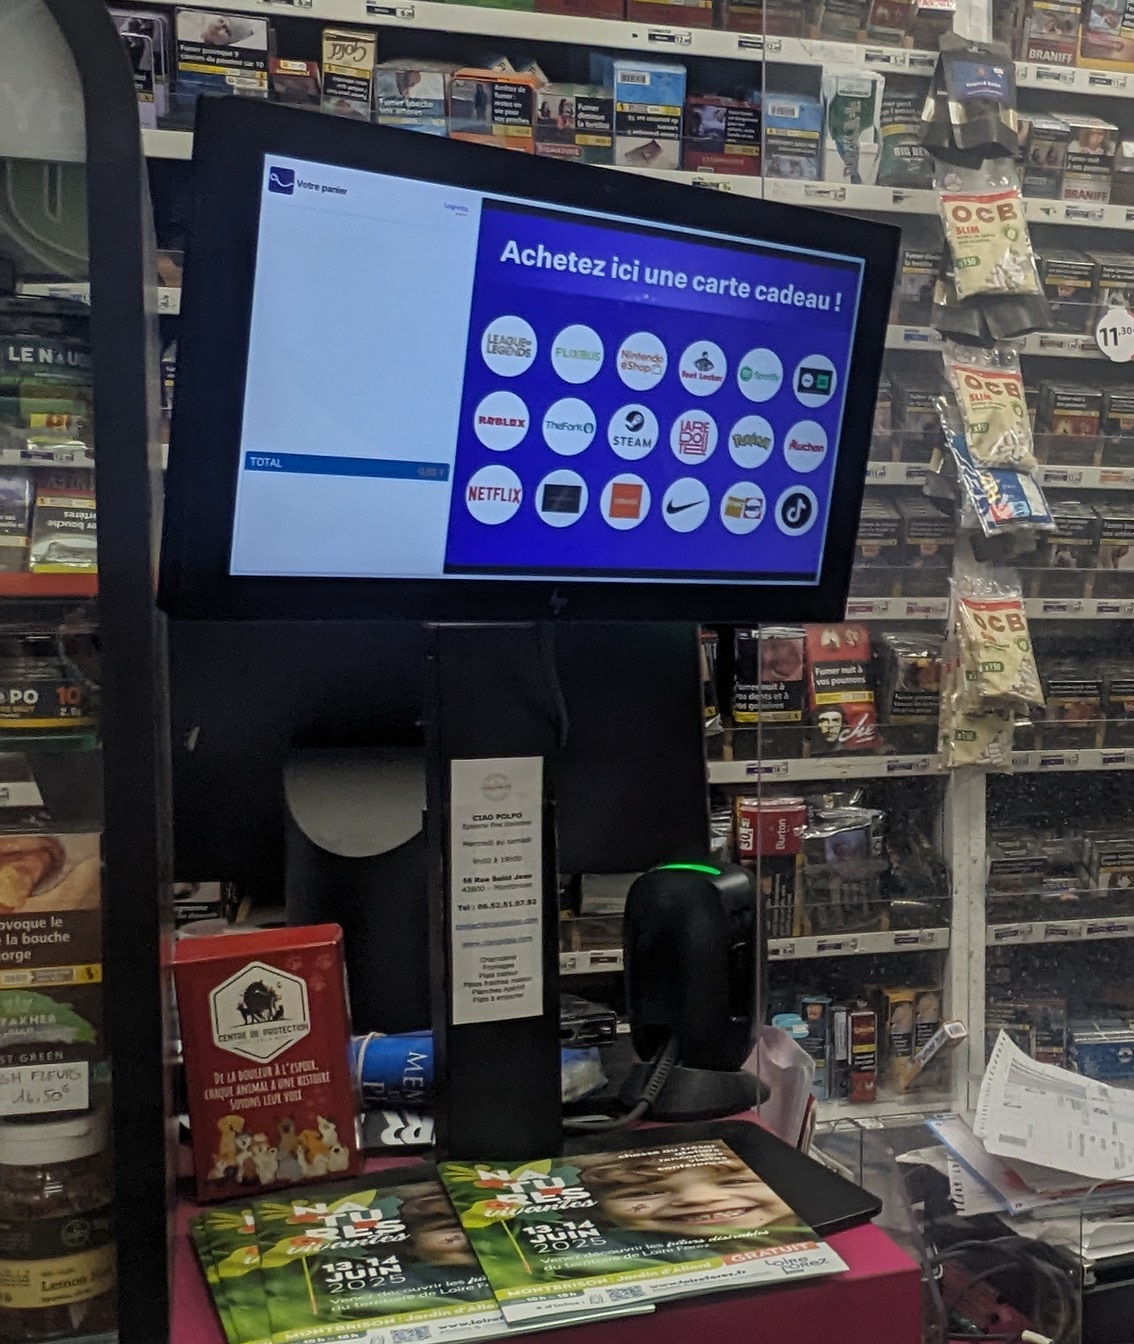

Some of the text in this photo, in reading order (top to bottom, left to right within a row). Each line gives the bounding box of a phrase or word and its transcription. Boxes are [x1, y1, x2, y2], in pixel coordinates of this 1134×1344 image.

[297, 179, 348, 197] Votre panier
[950, 202, 1018, 225] OCB
[955, 224, 980, 236] SLIM
[501, 239, 843, 312] Achetez ici une carte cadeau !
[487, 334, 526, 348] LEAGUE
[8, 346, 35, 362] LE
[486, 344, 531, 358] LEGENDS
[555, 346, 601, 362] FLIXBUS
[621, 349, 664, 363] Nintendo
[621, 360, 652, 375] eShop
[964, 374, 1023, 399] OCB
[968, 391, 995, 403] SLIM
[478, 415, 525, 429] ROBLOX
[544, 419, 583, 434] TheFork
[612, 435, 653, 448] STEAM
[788, 439, 824, 454] Auchan
[250, 456, 283, 468] TOTAL
[468, 485, 520, 504] NETFLIX
[972, 611, 1025, 633] OCB
[472, 814, 494, 822] CIAO
[52, 916, 63, 930] le
[7, 929, 71, 948] la bouche
[262, 1022, 310, 1038] PROTECTION
[522, 1219, 595, 1236] 13 14
[527, 1227, 601, 1245] JUIN
[534, 1236, 607, 1254] 2025
[541, 1241, 663, 1265] Venez découvrir les
[730, 1240, 819, 1263] GRATUIT
[321, 1255, 400, 1273] 13 14
[544, 1242, 710, 1271] du territoire de Loire Forez
[325, 1264, 402, 1284] JUIN
[328, 1275, 407, 1294] 2025
[419, 1290, 437, 1299] de
[440, 1284, 475, 1296] Loire
[507, 1276, 608, 1297] MONTBRISON
[615, 1269, 655, 1283] Jardin
[286, 1308, 453, 1340] MONTBRISON Jardin
